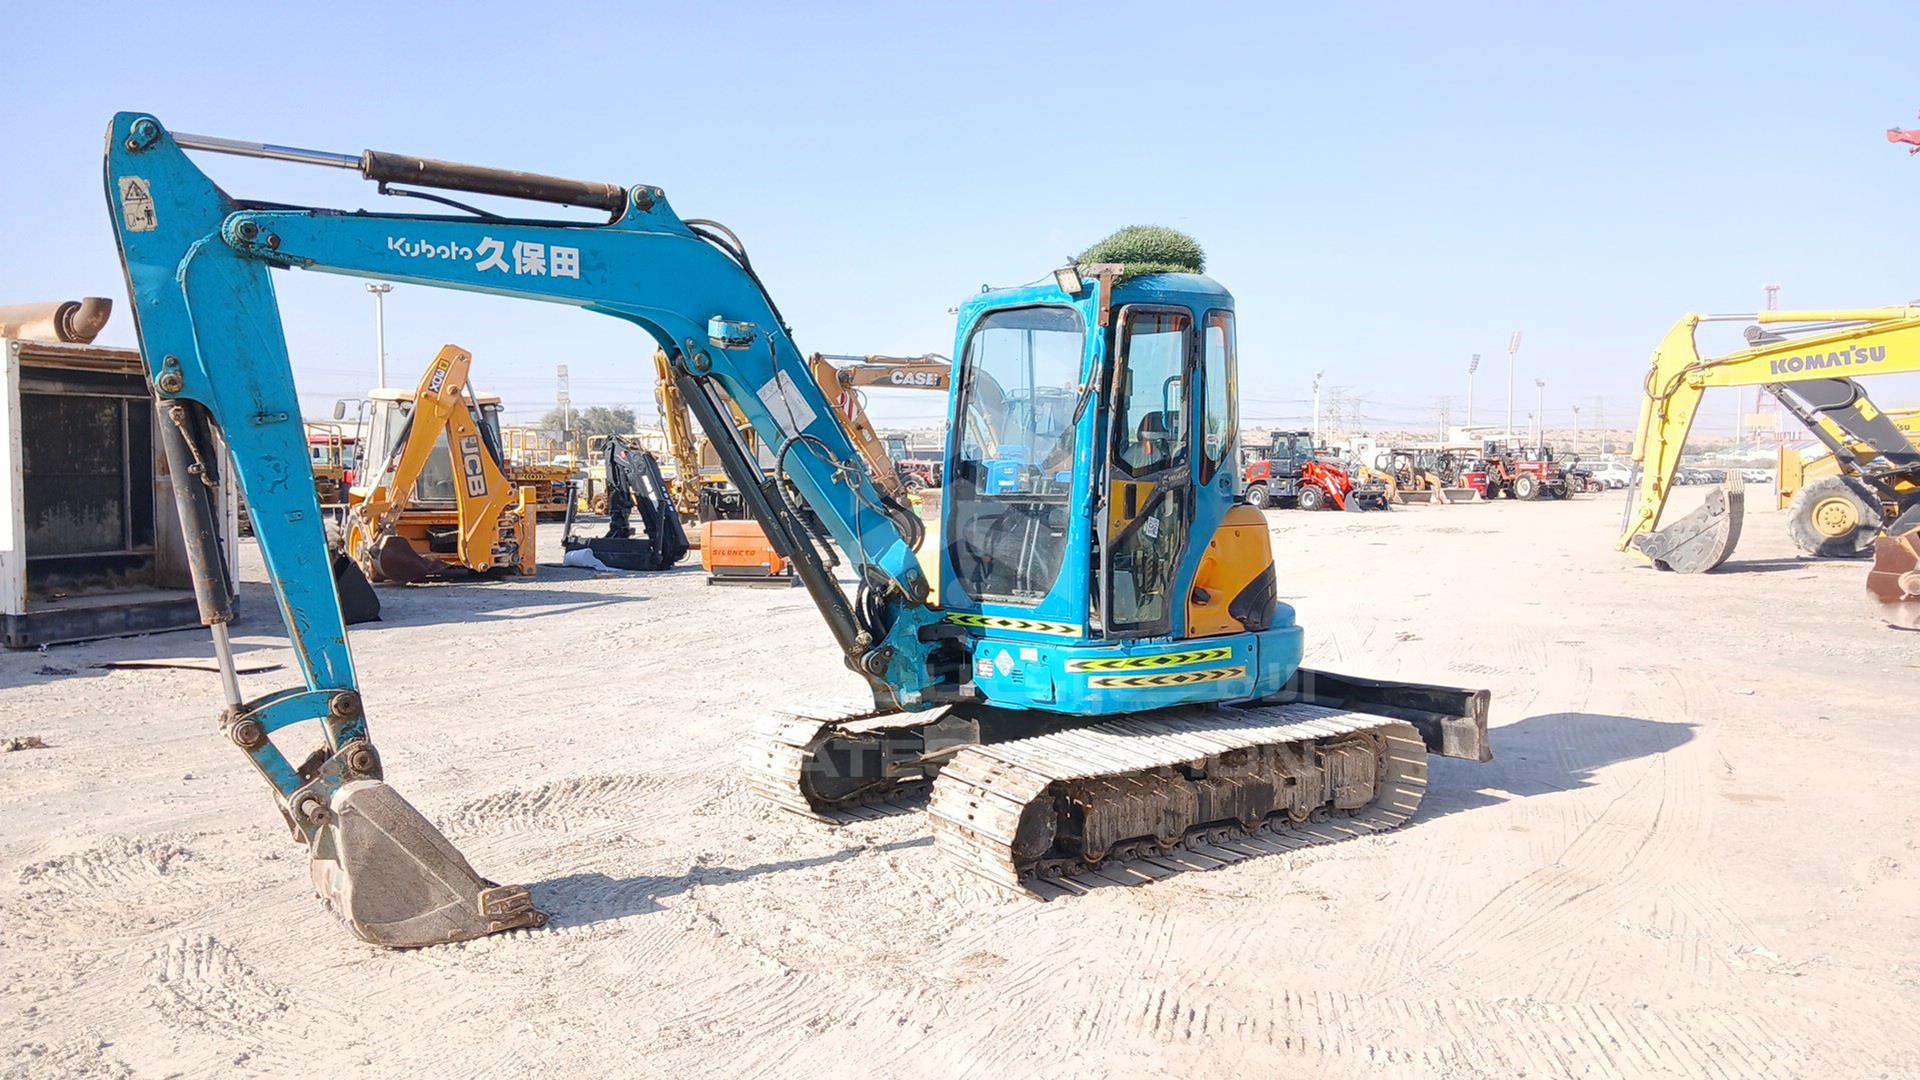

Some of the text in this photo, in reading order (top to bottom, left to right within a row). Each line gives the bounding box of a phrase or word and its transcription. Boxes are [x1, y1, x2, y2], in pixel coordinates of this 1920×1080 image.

[387, 236, 580, 279] Kubota 久保田
[1770, 345, 1886, 374] KOMATSU
[891, 372, 938, 386] CASE
[460, 436, 487, 497] JCB
